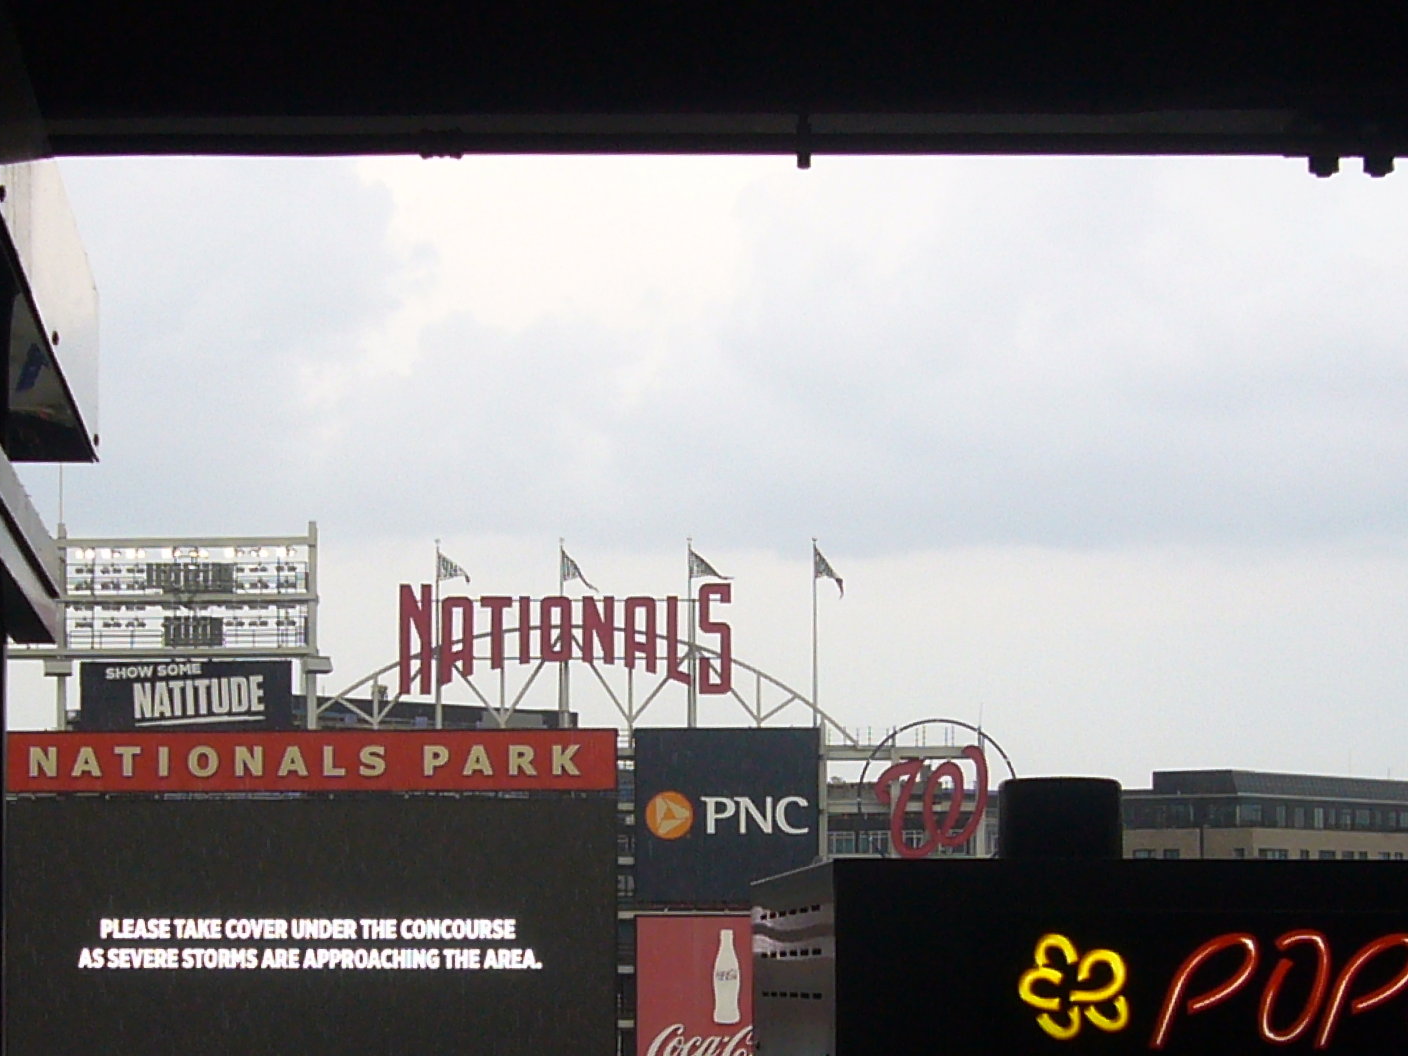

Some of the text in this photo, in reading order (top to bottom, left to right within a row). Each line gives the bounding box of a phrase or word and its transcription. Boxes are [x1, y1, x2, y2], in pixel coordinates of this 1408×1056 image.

[399, 583, 731, 694] NATIONALS
[105, 663, 202, 680] SHOW SOME
[133, 675, 265, 719] NATITUDE
[29, 744, 581, 777] NATIONALS PARK
[700, 796, 810, 835] PNC
[100, 918, 516, 940] PLEASE TAKE COVER UNDER THE CONCOURSE
[78, 948, 543, 970] AS SEVERE STORMS ARE APPROACHING THE AREA.
